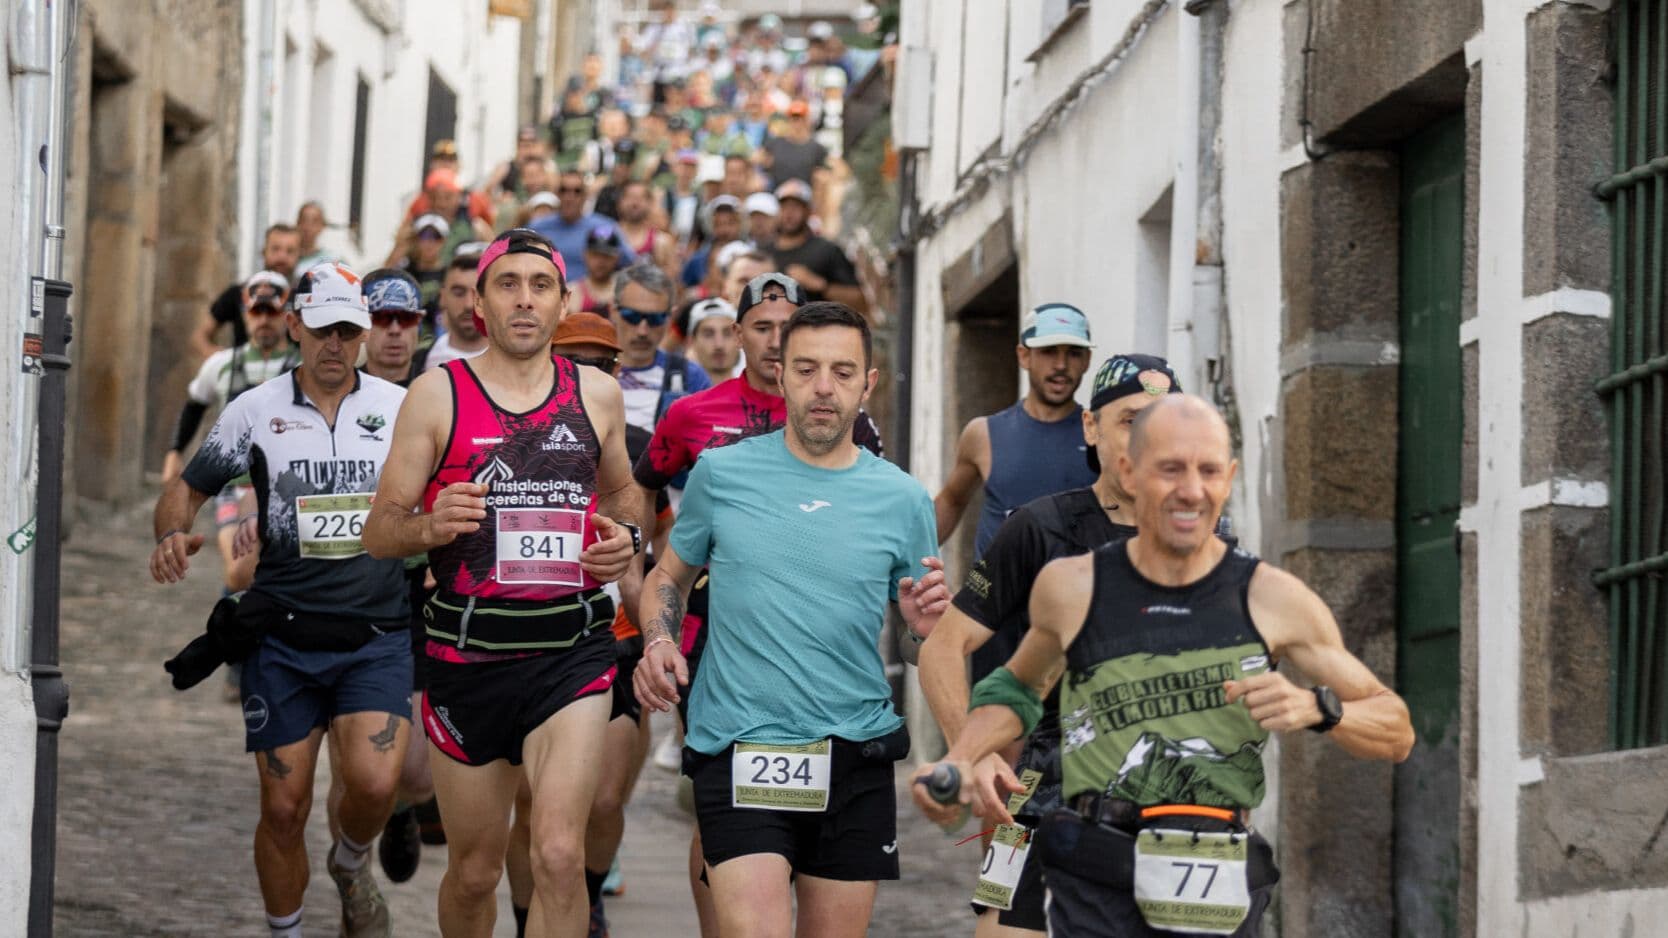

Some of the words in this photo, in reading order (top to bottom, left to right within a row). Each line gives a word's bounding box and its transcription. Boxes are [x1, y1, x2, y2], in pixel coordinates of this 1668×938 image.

[542, 442, 586, 452] islasport
[486, 492, 544, 506] cereñas
[548, 491, 565, 503] de
[568, 493, 592, 506] Ga
[492, 479, 583, 494] Instalaciones
[313, 513, 363, 538] 226
[520, 535, 564, 559] 841
[751, 755, 813, 786] 234
[1171, 861, 1219, 899] 77
